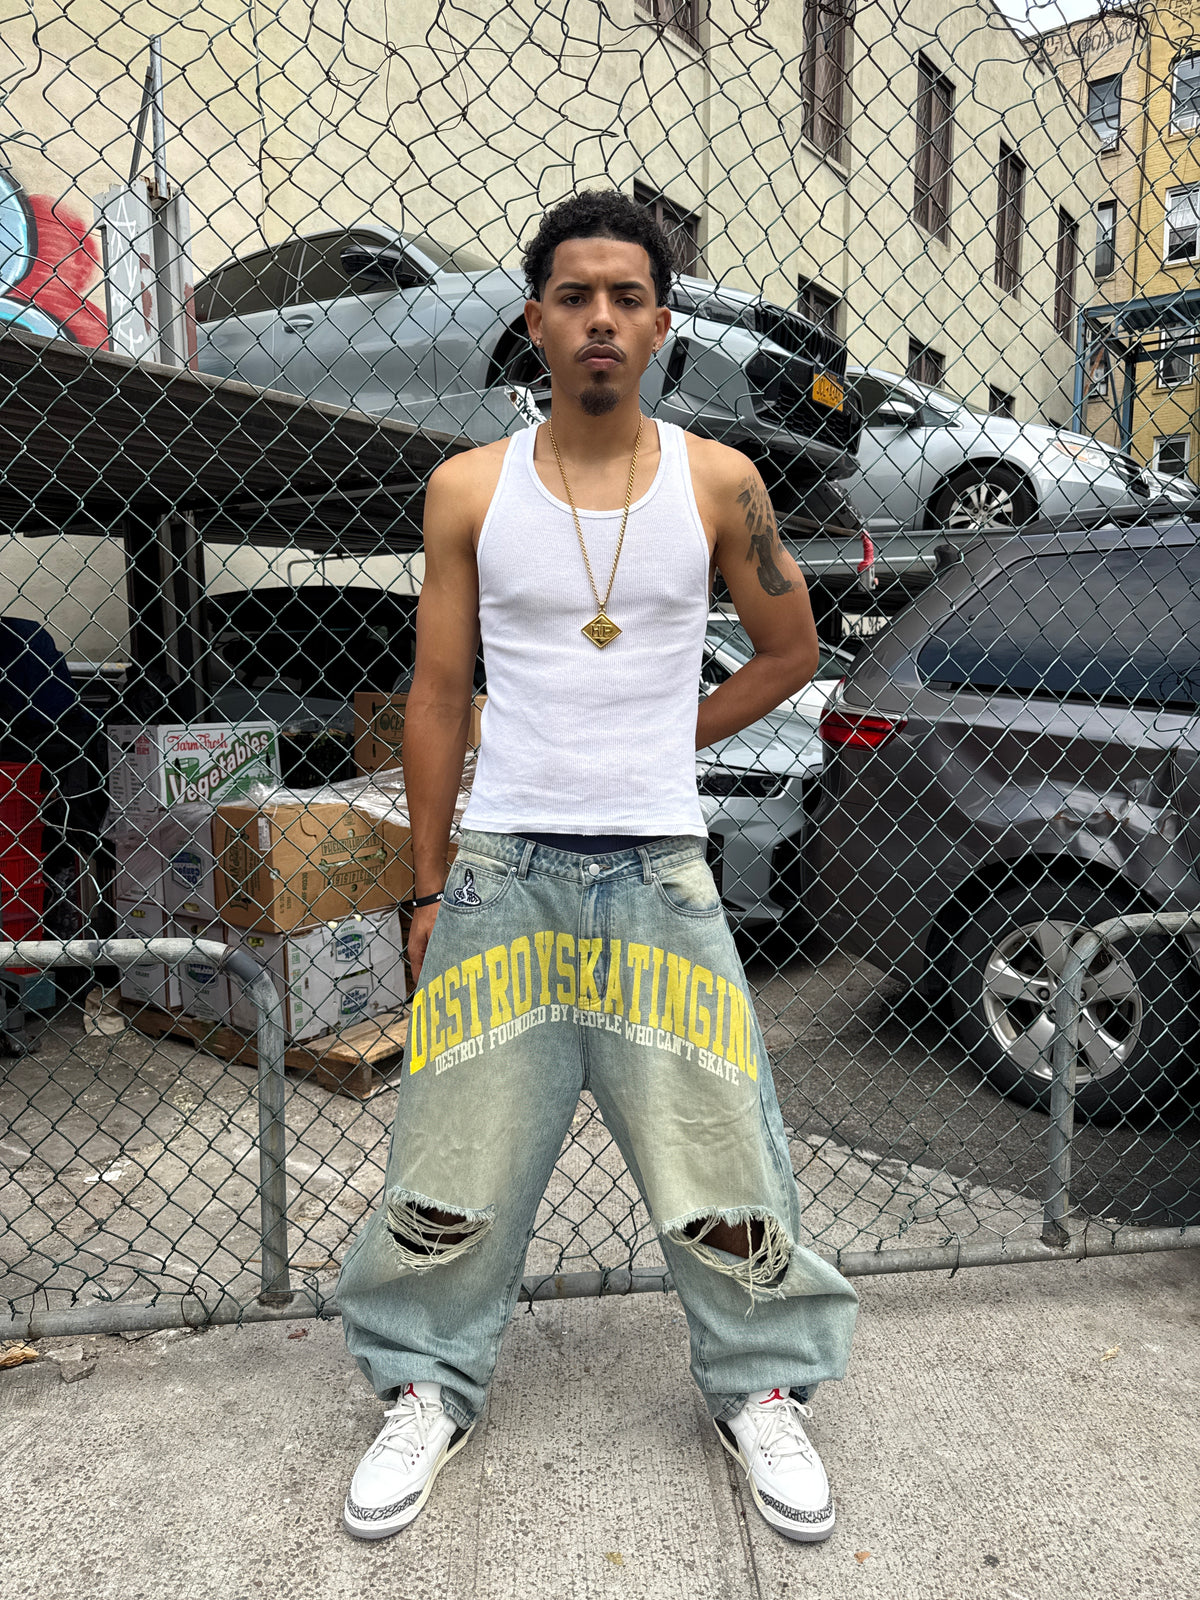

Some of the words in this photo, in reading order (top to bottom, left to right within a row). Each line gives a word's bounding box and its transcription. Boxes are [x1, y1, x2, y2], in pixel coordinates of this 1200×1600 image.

[167, 735, 201, 751] Farm
[168, 732, 270, 804] Vegetables
[435, 1034, 484, 1076] DESTROY
[489, 1005, 546, 1050] FOUNDED
[550, 1004, 569, 1022] BY
[572, 1006, 622, 1034] PEOPLE
[625, 1020, 653, 1047] WHO
[656, 1029, 694, 1061] CAN'T
[698, 1047, 740, 1086] SKATE
